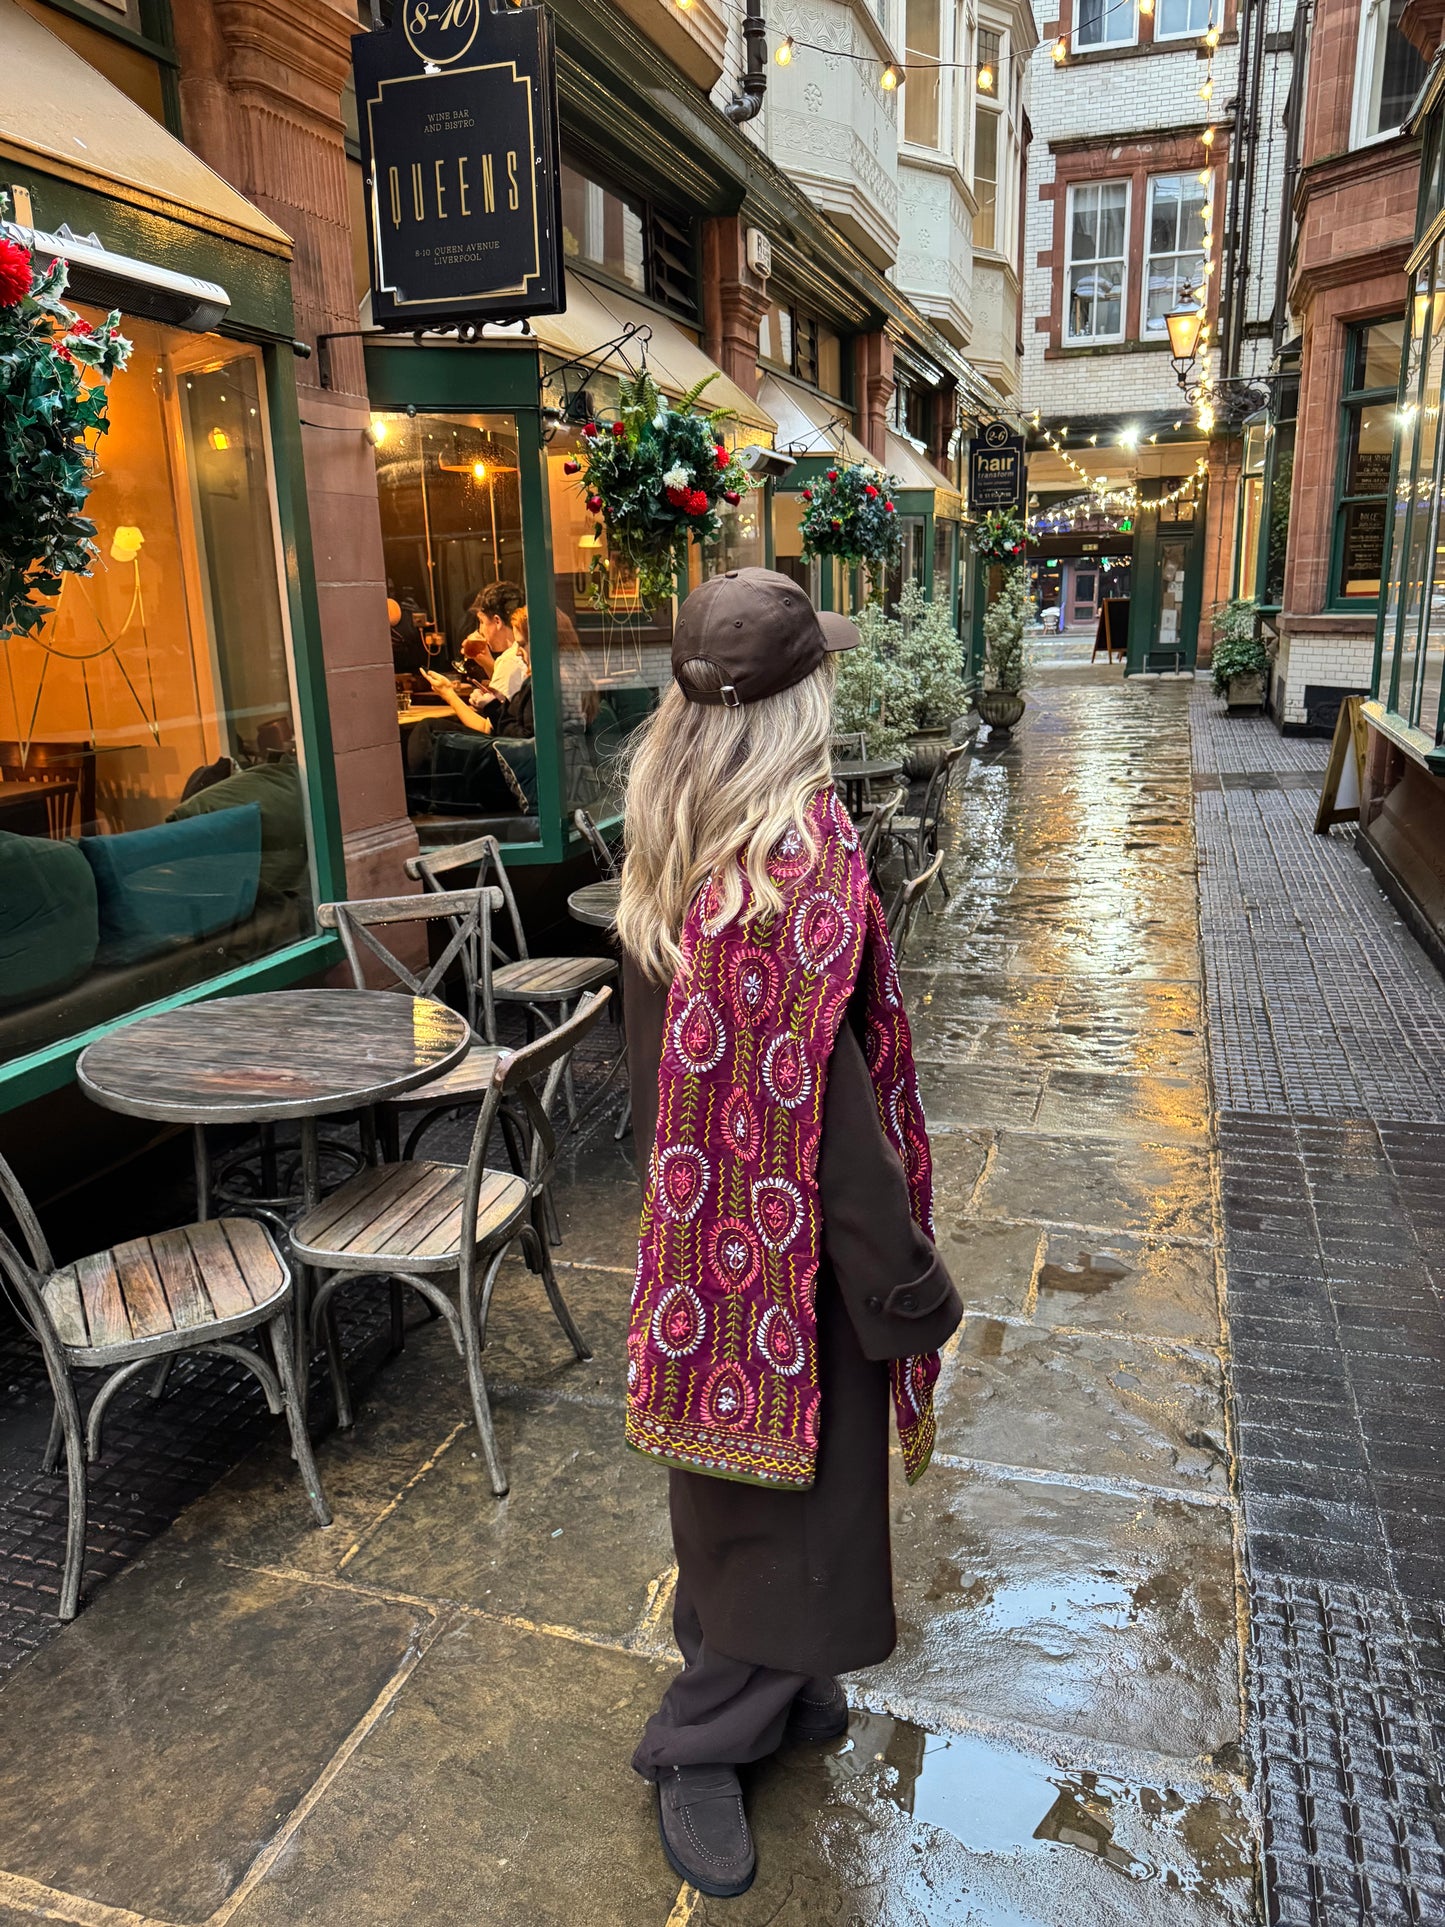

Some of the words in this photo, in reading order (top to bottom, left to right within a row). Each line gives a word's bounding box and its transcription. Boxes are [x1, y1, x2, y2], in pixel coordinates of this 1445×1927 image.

[409, 0, 473, 34] 8-10
[427, 111, 451, 122] WINE
[452, 109, 470, 119] BAR
[423, 123, 442, 133] AND
[444, 118, 475, 130] BISTRO
[388, 151, 519, 230] QUEENS
[415, 249, 431, 257] 8-10
[434, 244, 464, 256] QUEEN
[466, 240, 501, 252] AVENUE
[434, 253, 482, 265] LIVERPOOL
[988, 431, 1006, 441] 2-6
[977, 455, 1015, 472] hair
